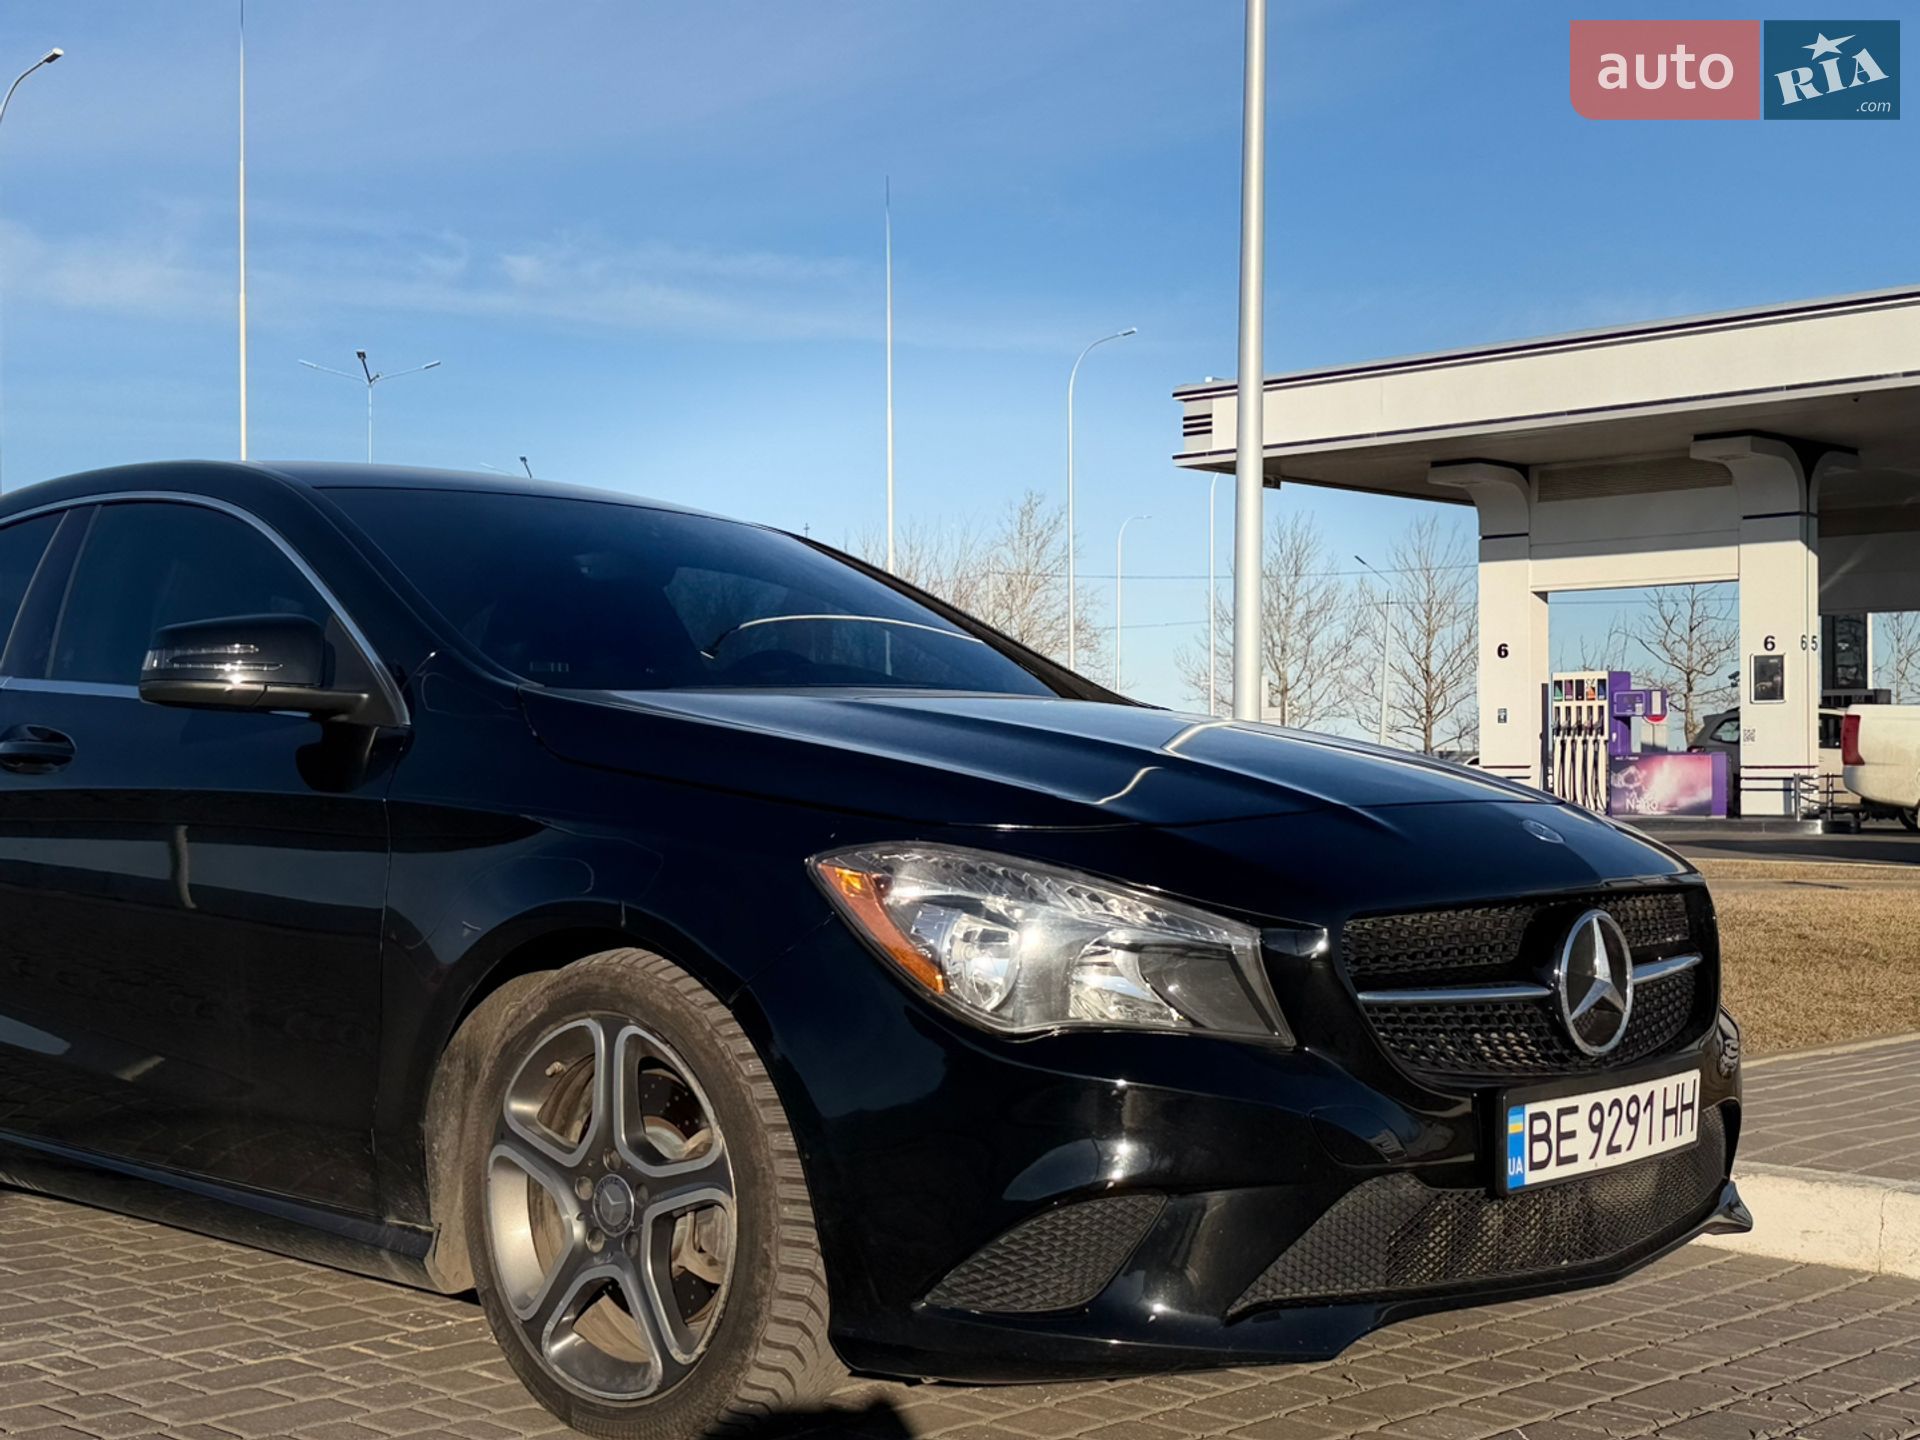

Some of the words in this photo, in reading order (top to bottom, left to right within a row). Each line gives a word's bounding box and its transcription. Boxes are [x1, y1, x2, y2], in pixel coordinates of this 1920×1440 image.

[1764, 636, 1775, 651] 6
[1801, 635, 1808, 650] 6
[1811, 636, 1818, 651] 5
[1497, 643, 1509, 658] 6
[1528, 1104, 1579, 1172] BE
[1588, 1089, 1655, 1160] 9291
[1661, 1078, 1697, 1142] HH
[1508, 1158, 1524, 1175] UA
